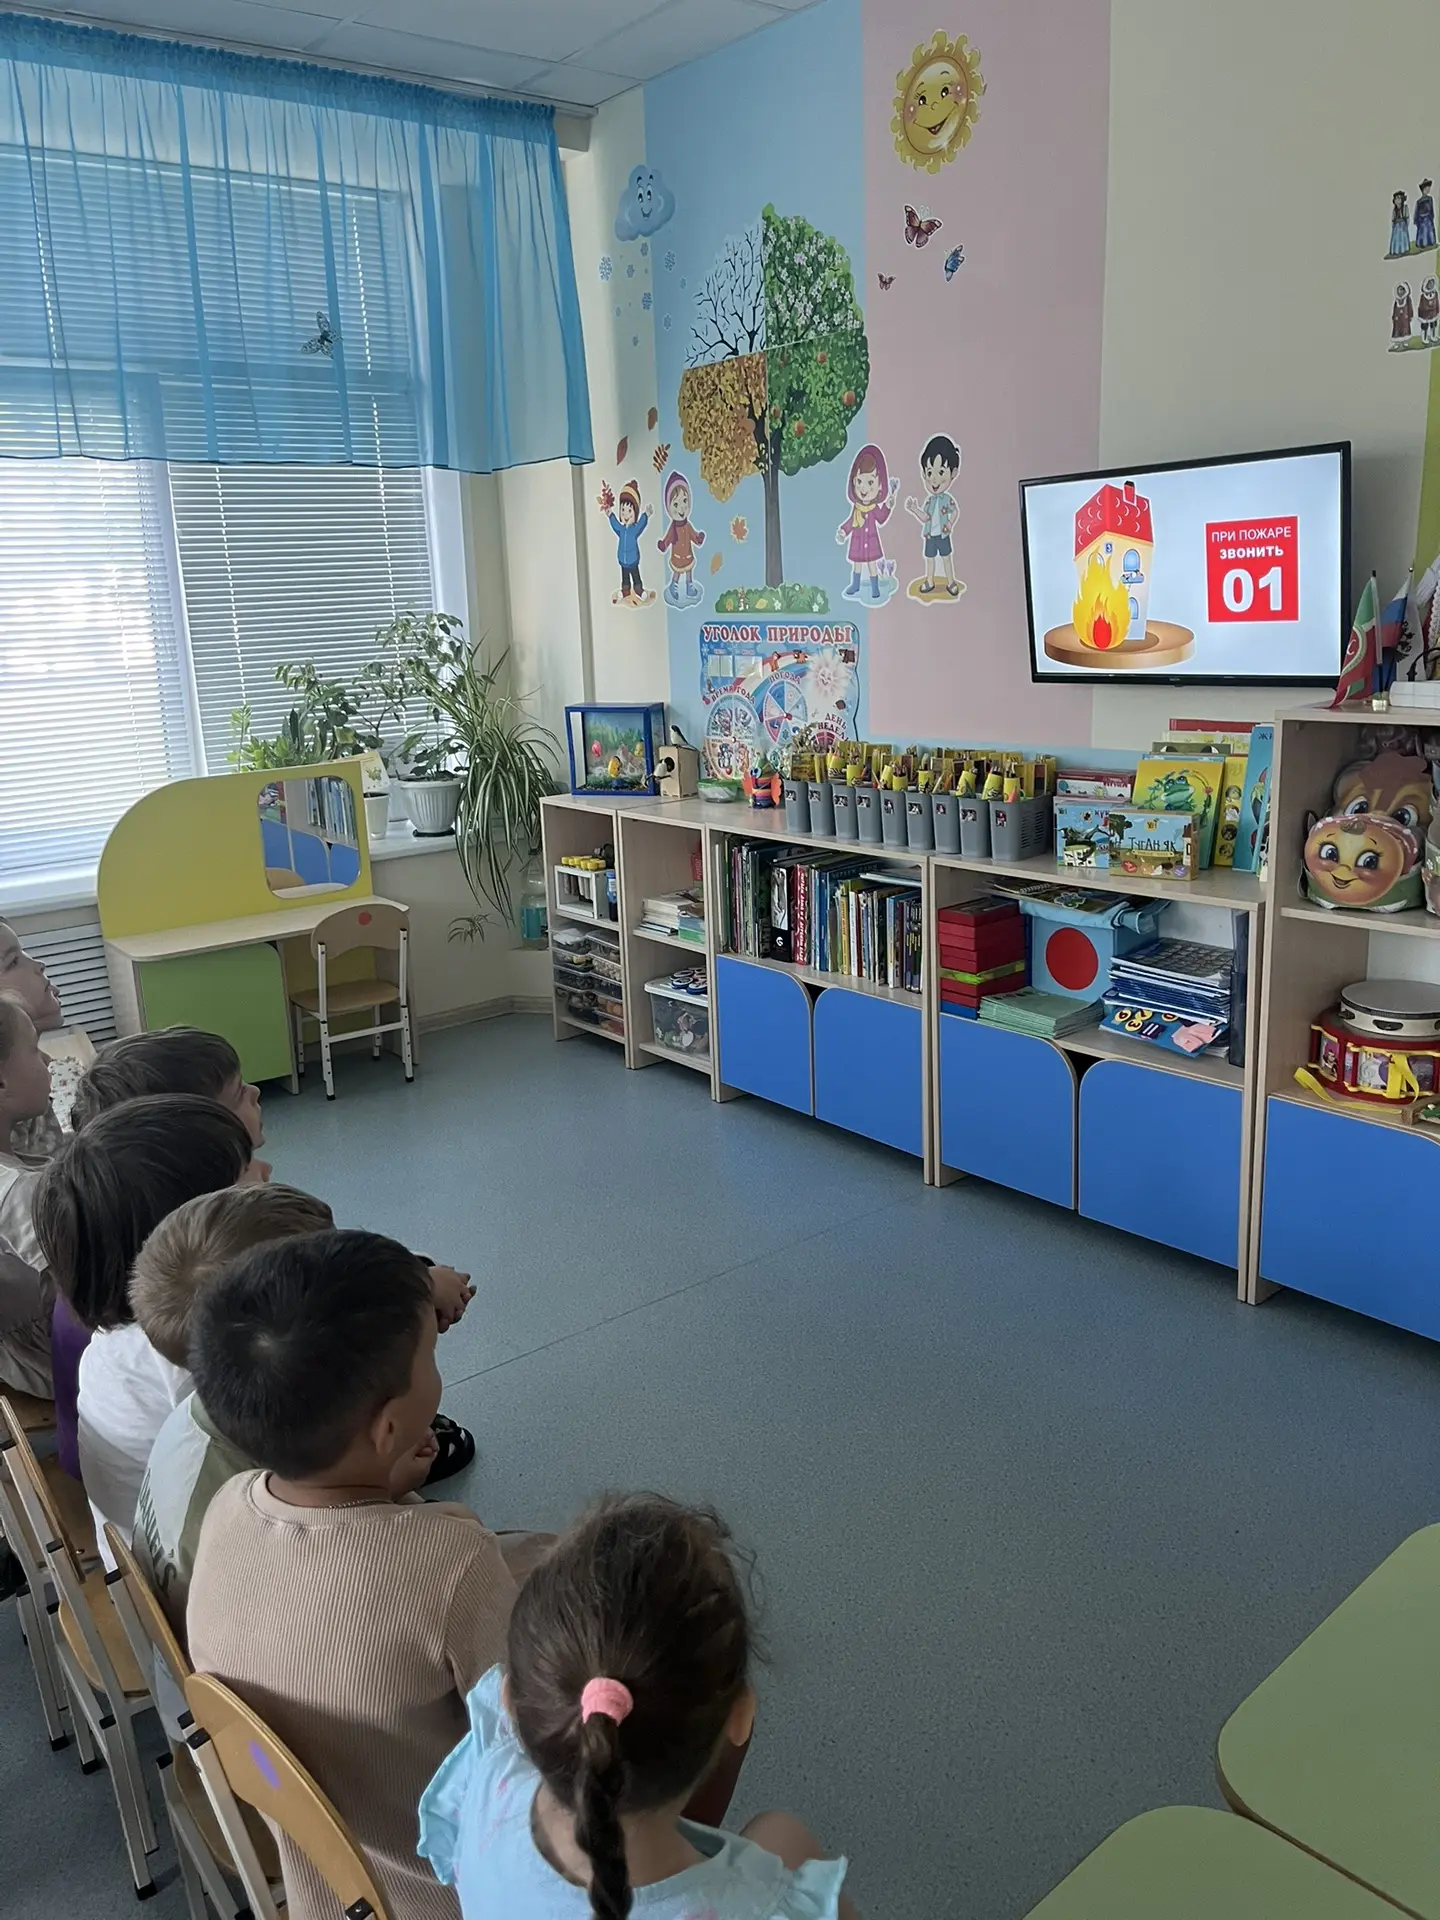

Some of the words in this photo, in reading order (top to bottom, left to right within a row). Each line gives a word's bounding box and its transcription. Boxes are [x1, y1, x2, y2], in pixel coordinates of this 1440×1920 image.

[1211, 531, 1236, 543] ПРИ
[1239, 526, 1292, 541] ПОЖАРЕ
[1223, 566, 1282, 613] 01
[703, 626, 761, 642] УГОЛОК
[767, 626, 852, 644] ПРИРОДЫ
[769, 671, 801, 685] ПОГОДА
[736, 686, 756, 705] ГОДА
[825, 712, 847, 729] ДЕНЬ
